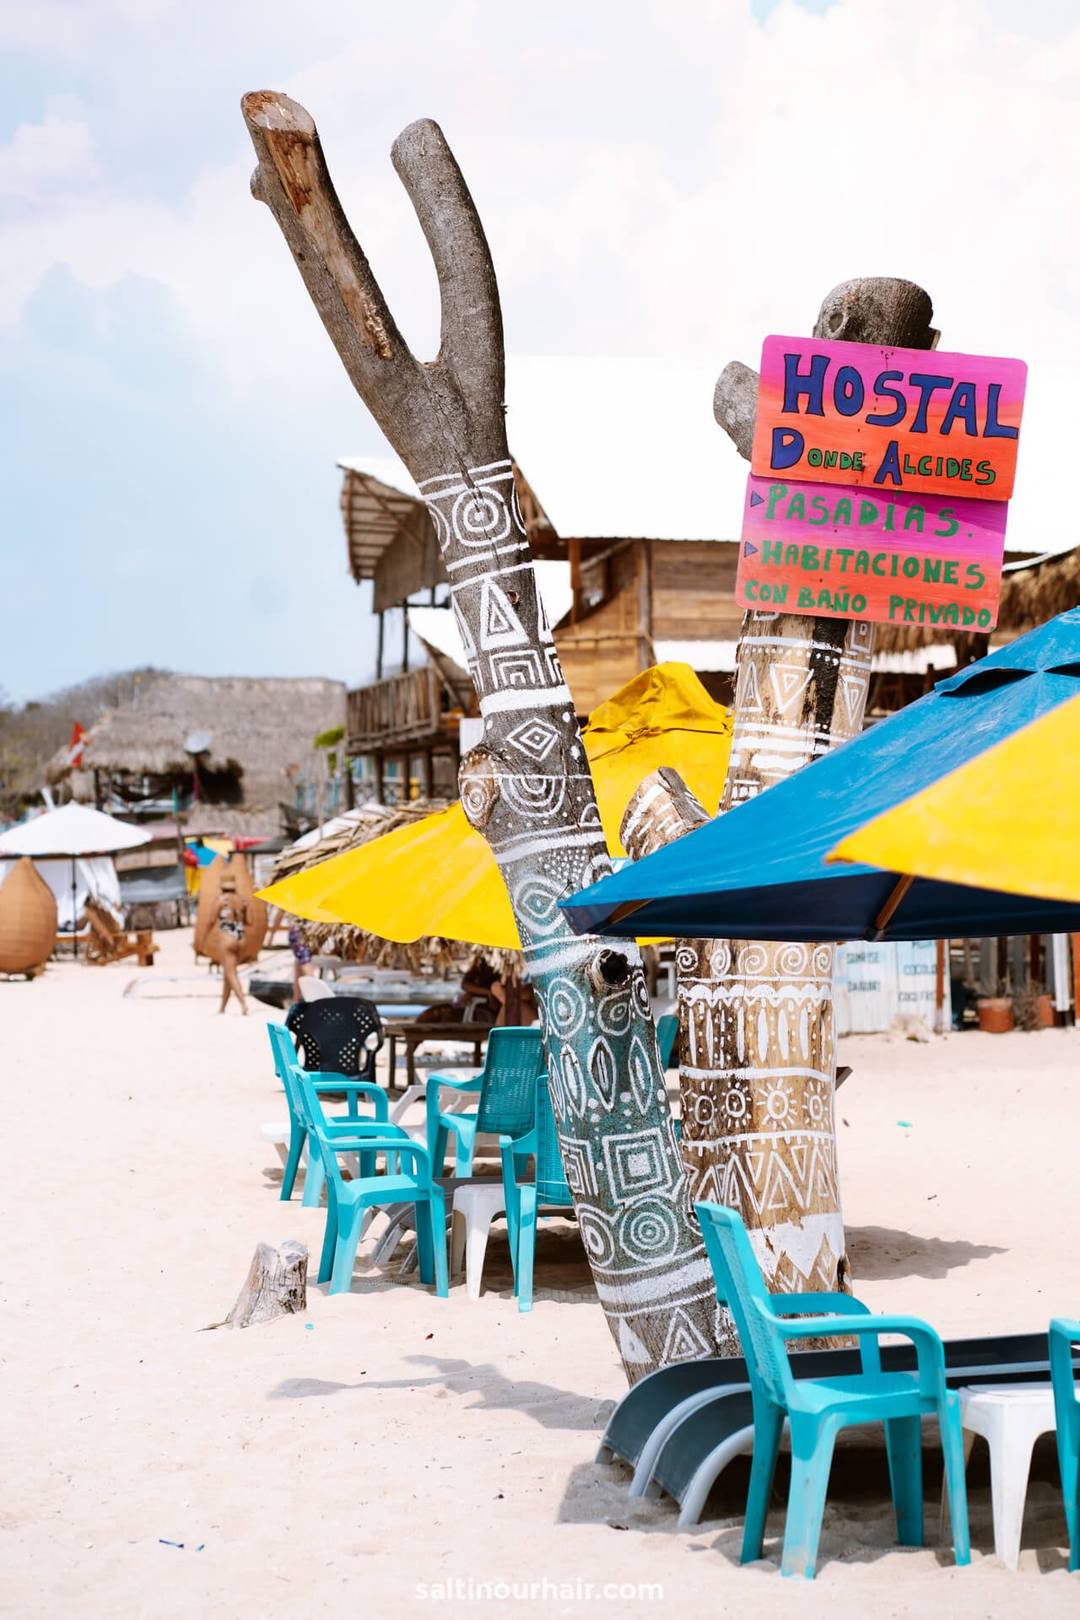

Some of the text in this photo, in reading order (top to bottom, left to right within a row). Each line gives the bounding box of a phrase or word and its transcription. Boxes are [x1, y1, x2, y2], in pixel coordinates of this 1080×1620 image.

[781, 353, 1019, 439] HOSTAL
[770, 427, 996, 485] DONDE ALCIDES
[761, 540, 985, 590] HABITACIONES
[744, 580, 788, 604] CON
[796, 585, 867, 613] BAÑO
